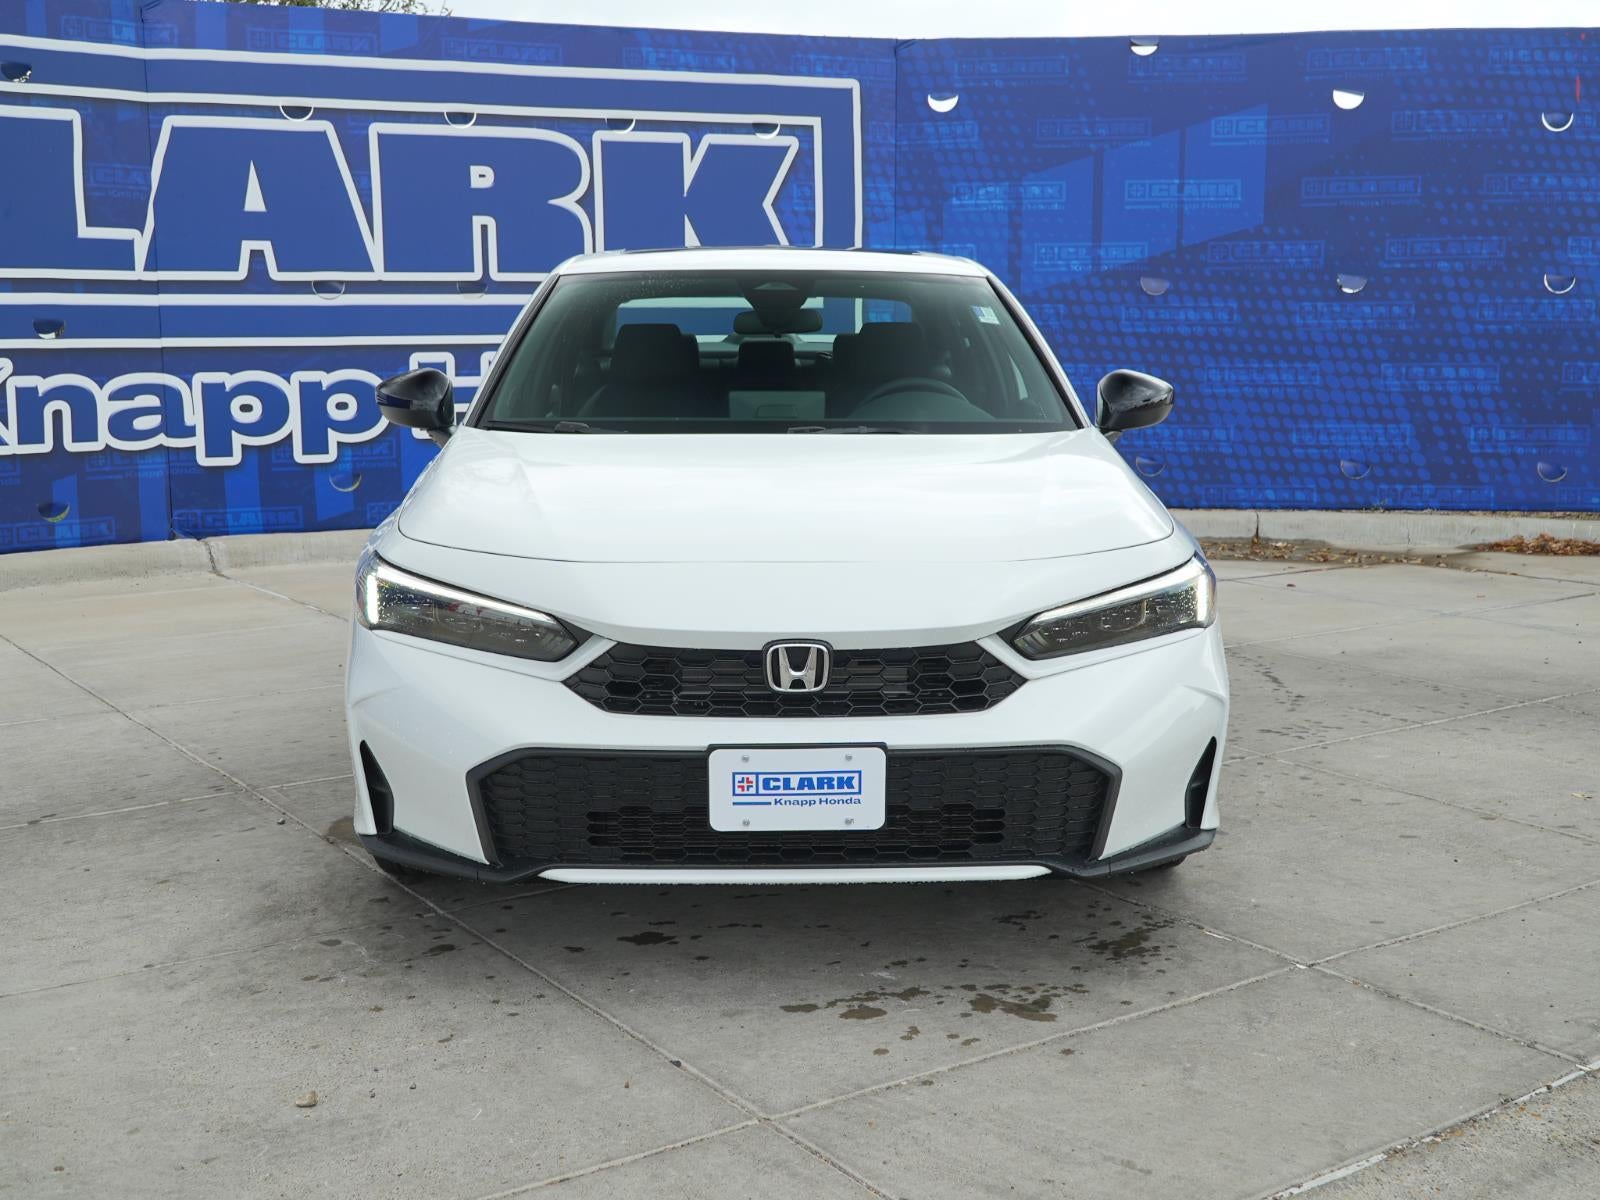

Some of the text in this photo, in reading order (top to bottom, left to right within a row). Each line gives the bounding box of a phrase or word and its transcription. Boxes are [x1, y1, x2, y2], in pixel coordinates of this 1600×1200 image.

[762, 776, 855, 791] CLARK
[774, 797, 861, 807] Knapp Honda
